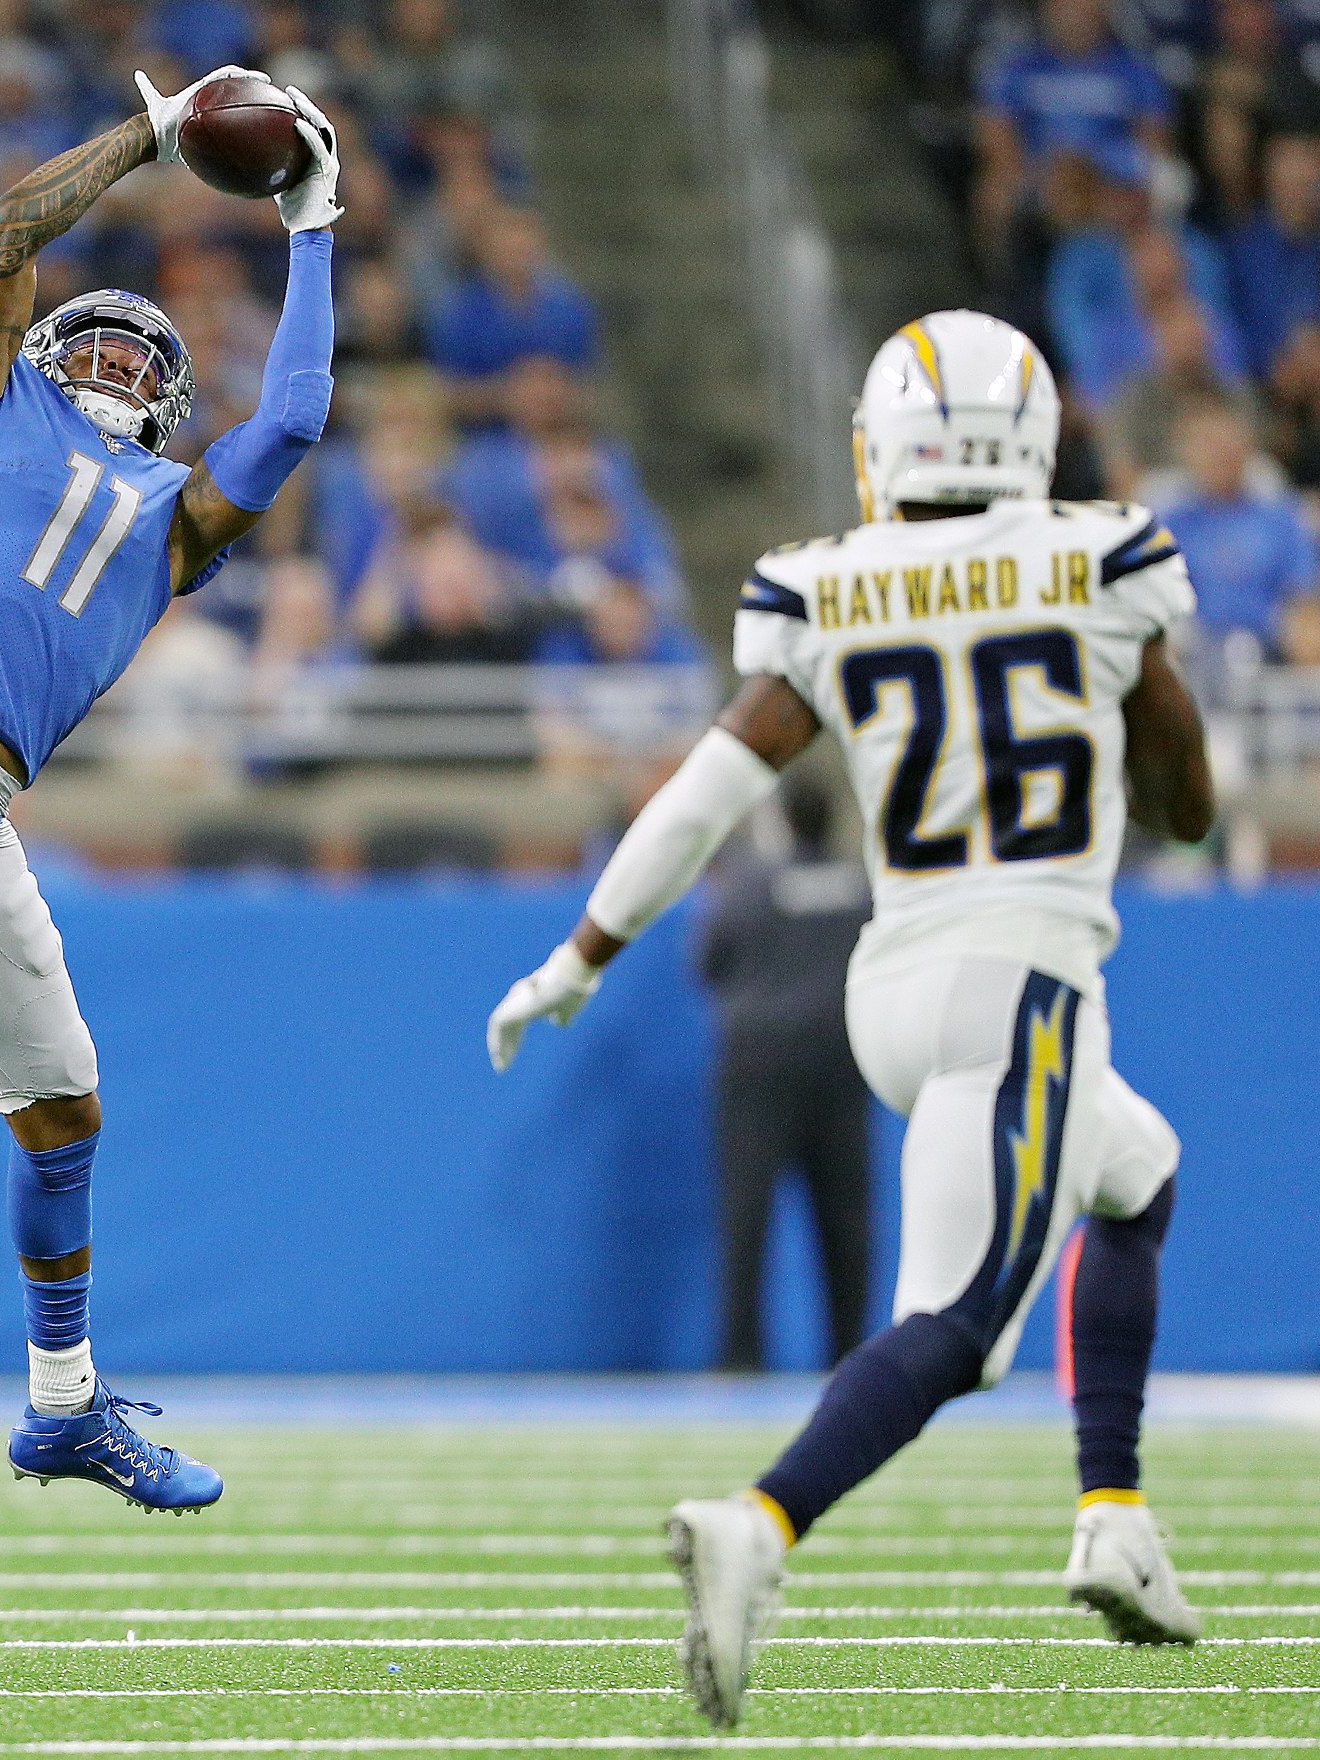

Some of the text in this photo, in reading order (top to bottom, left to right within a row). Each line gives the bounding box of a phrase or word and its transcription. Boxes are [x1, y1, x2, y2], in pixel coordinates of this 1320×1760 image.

[21, 451, 142, 618] 11
[816, 550, 1090, 629] HAYWARD JR
[837, 624, 1095, 875] 26
